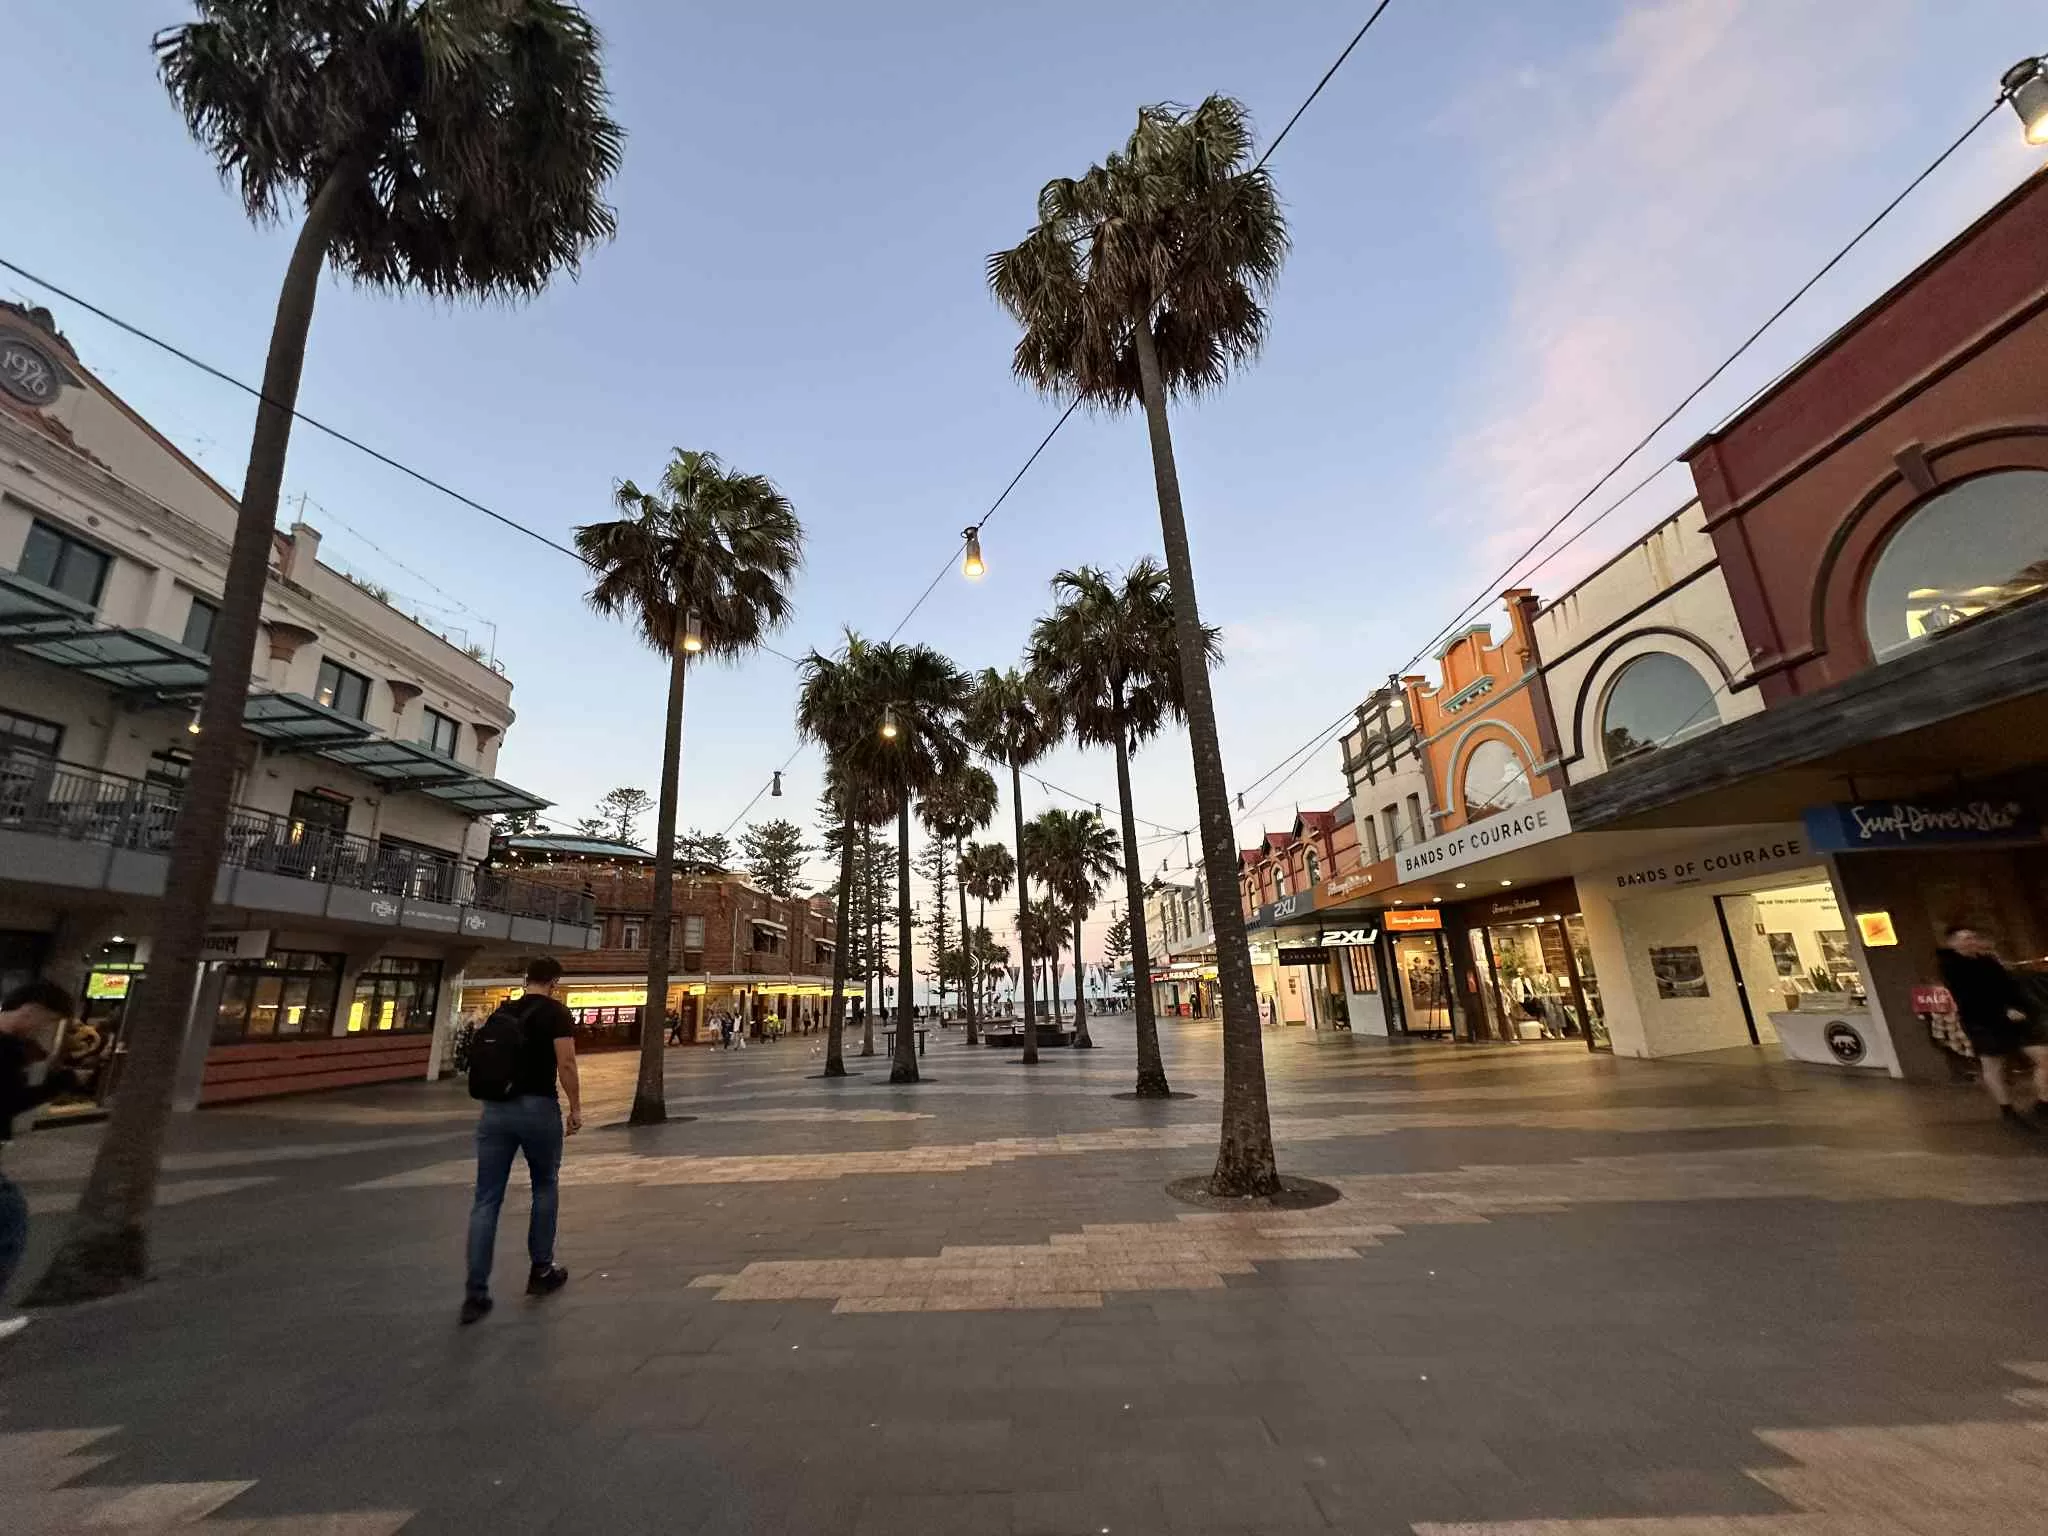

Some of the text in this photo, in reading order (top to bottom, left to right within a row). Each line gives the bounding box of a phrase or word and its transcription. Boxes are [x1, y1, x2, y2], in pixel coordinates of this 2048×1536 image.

[3, 351, 49, 395] 1926
[1406, 811, 1548, 872] BANDS OF COURAGE
[1615, 840, 1801, 888] BANDS OF COURAGE
[1274, 897, 1296, 918] 2XU
[202, 935, 239, 953] OOM
[1321, 929, 1378, 946] 2XU
